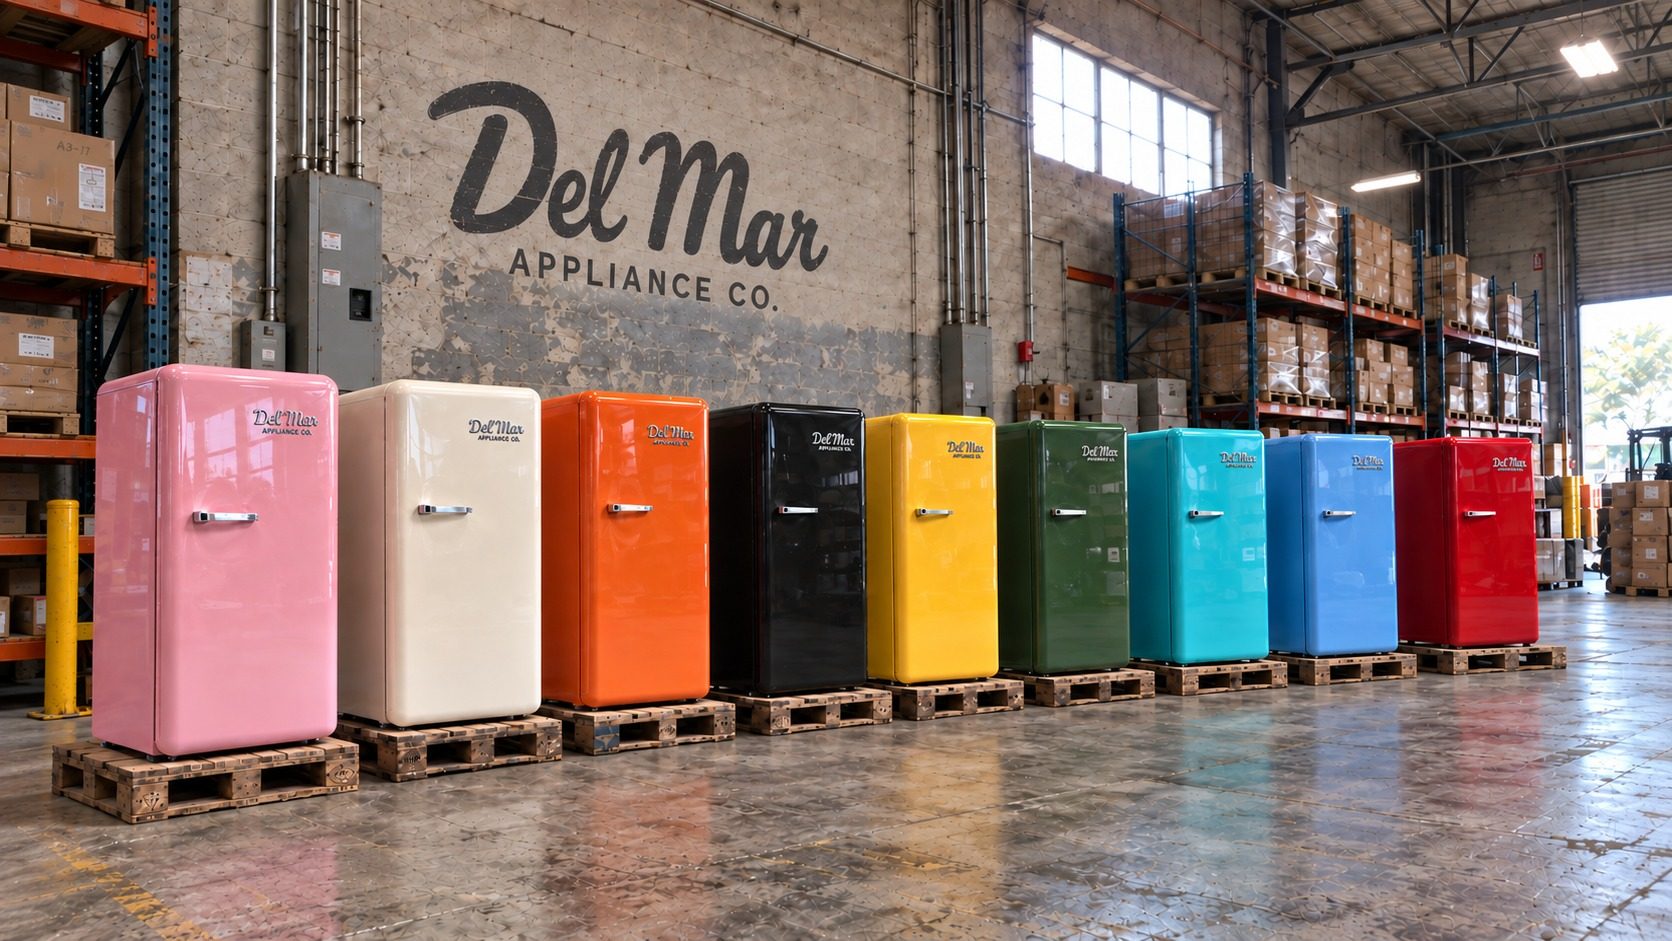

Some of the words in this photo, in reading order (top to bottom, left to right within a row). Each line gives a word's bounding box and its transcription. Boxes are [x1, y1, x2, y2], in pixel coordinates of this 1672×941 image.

[427, 80, 630, 242] Del
[638, 131, 829, 272] Mar
[509, 248, 712, 302] APPLIANCE
[728, 281, 778, 312] CO.
[252, 410, 282, 427] Del
[282, 411, 319, 428] Mar
[469, 419, 494, 434] Del
[494, 420, 524, 434] Mar
[262, 427, 299, 436] APPLIANCE
[648, 424, 669, 438] Del
[670, 425, 695, 440] Mar
[811, 431, 831, 445] Del
[832, 432, 855, 446] Mar
[946, 441, 965, 453] Del
[965, 441, 984, 453] Mar
[1081, 445, 1098, 457] Del
[1098, 445, 1118, 457] Mar
[1492, 457, 1508, 468] Del
